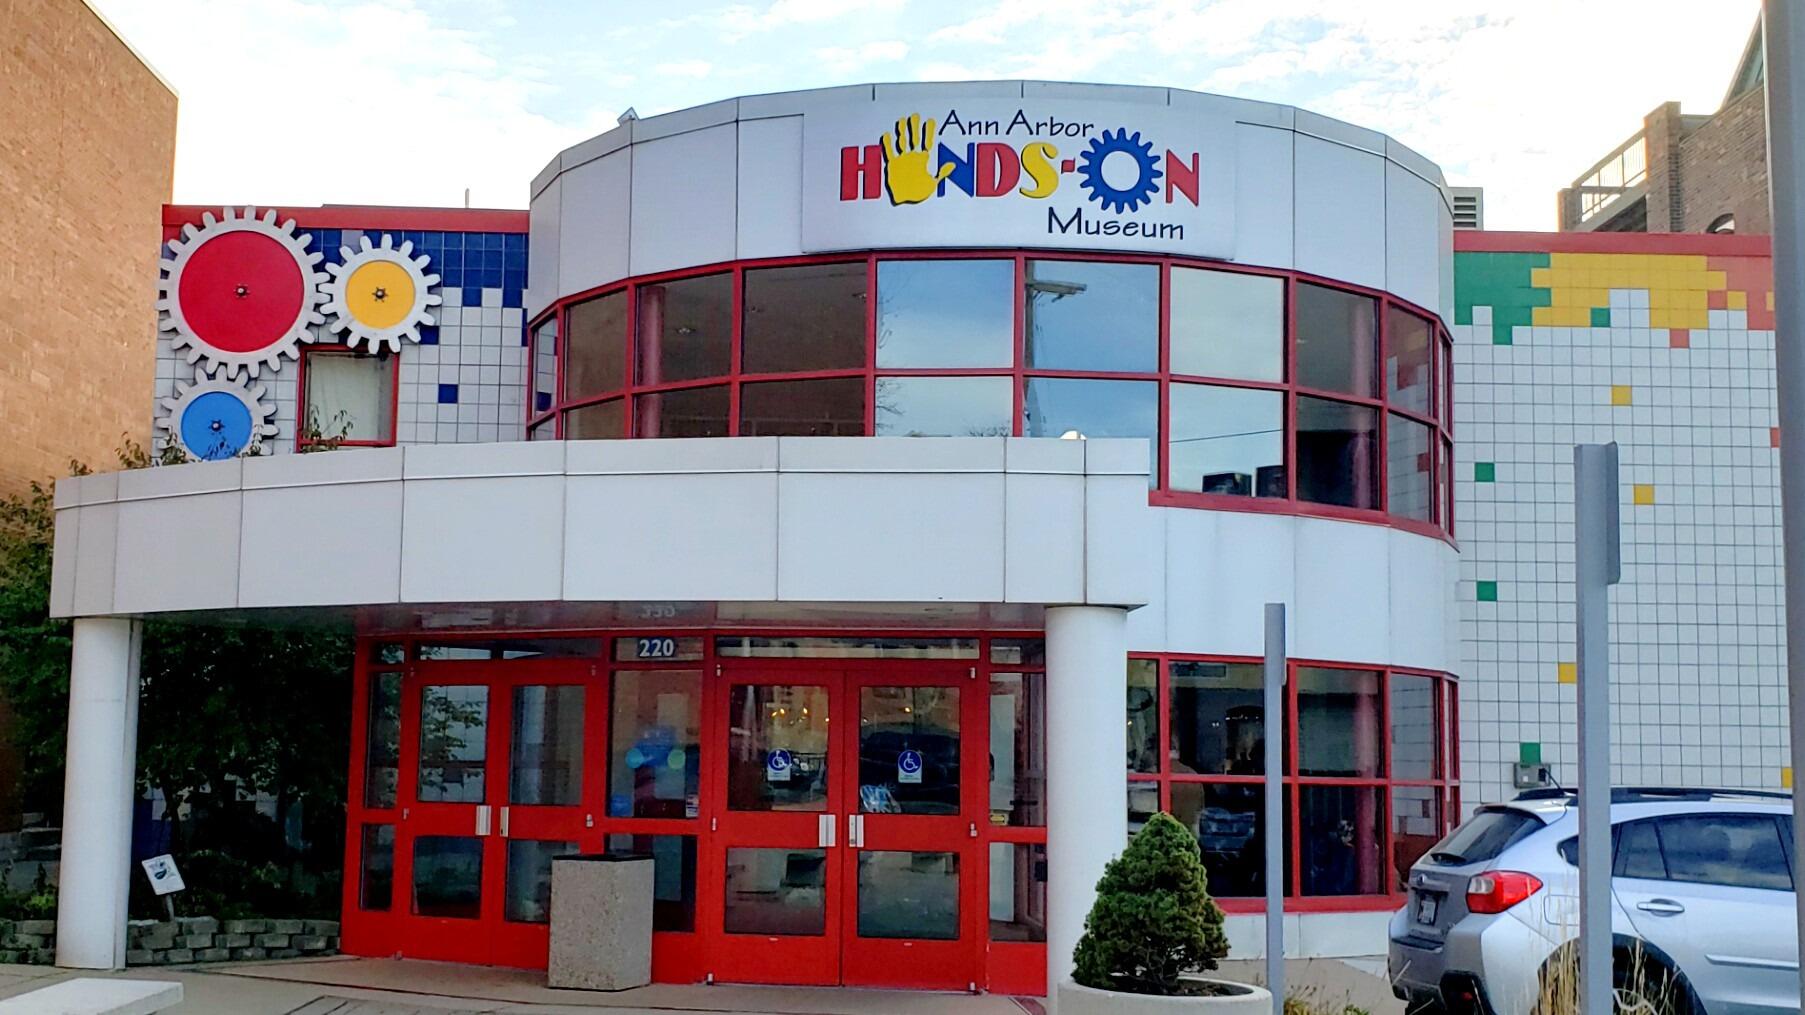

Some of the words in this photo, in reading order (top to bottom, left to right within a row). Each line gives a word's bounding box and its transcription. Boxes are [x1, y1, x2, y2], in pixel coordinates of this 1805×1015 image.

[938, 110, 999, 136] Ann
[1005, 109, 1095, 138] Arbor
[1047, 206, 1184, 240] Museum
[639, 638, 674, 657] 220
